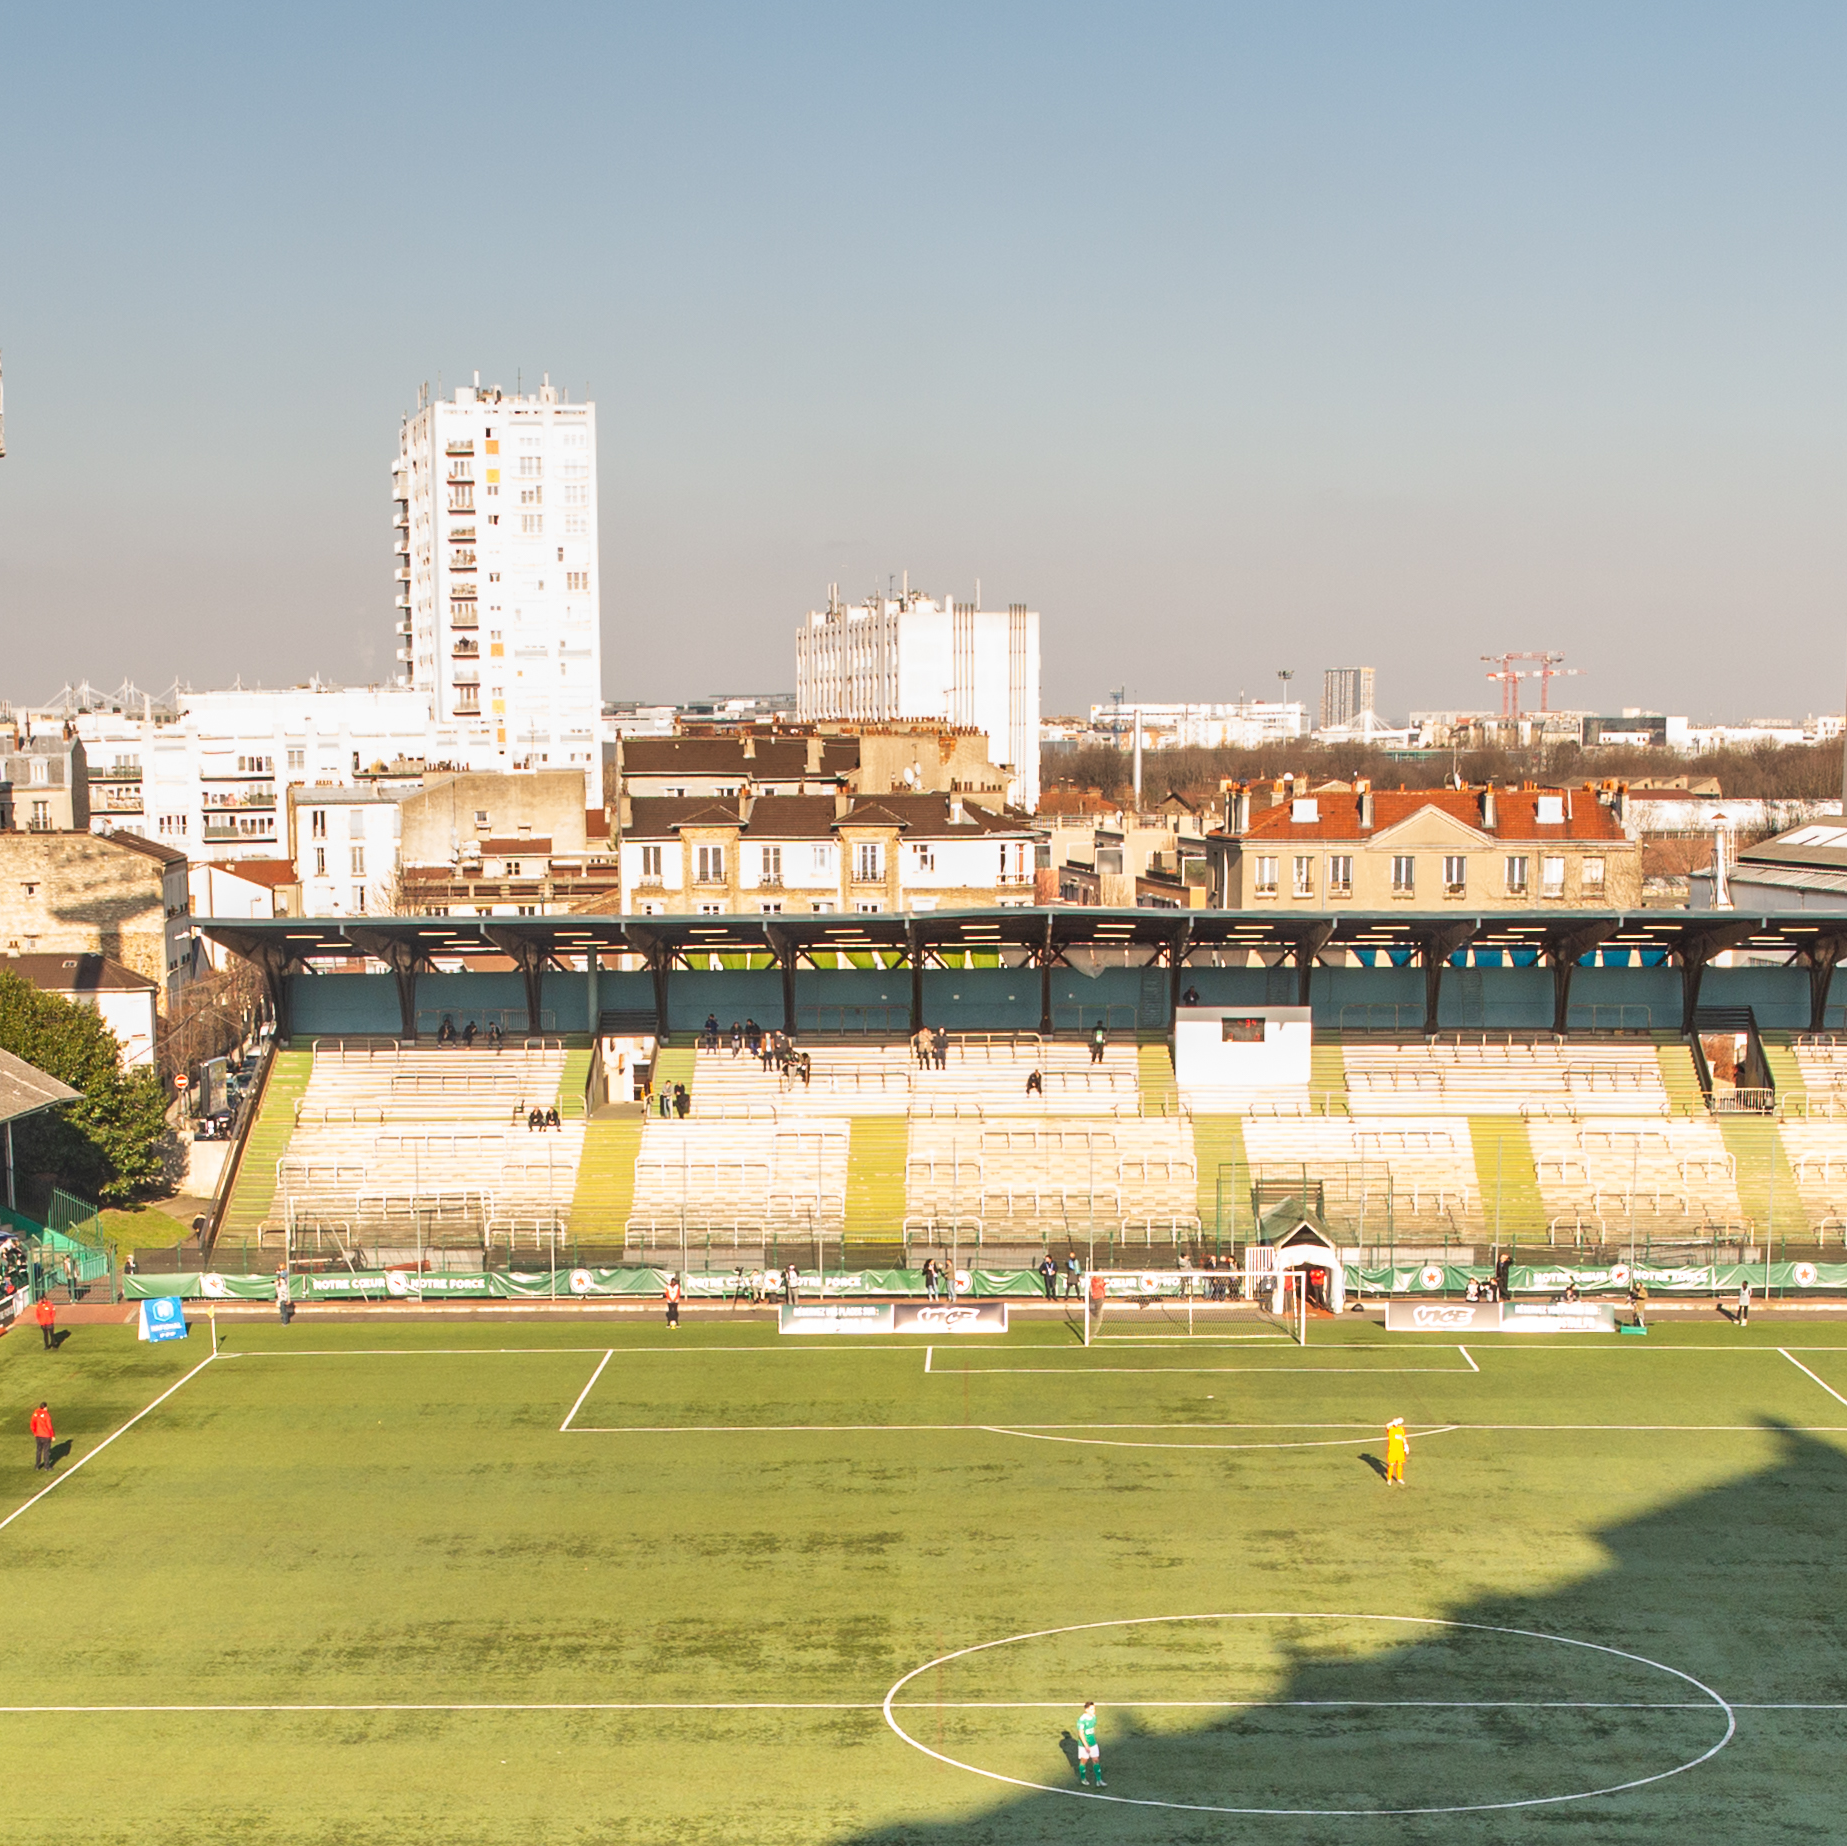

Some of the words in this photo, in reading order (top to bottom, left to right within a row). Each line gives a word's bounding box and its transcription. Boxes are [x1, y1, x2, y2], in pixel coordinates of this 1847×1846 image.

[1533, 1271, 1569, 1284] NOTRE
[1632, 1270, 1669, 1281] NOTRE
[313, 1279, 350, 1291] NOTRE
[351, 1278, 386, 1290] CŒUR
[408, 1279, 447, 1290] NOTRE
[448, 1278, 485, 1290] FORCE
[687, 1276, 729, 1288] NOTRE
[823, 1276, 862, 1288] FORCE
[917, 1306, 981, 1330] VICE
[1412, 1305, 1476, 1327] VICE
